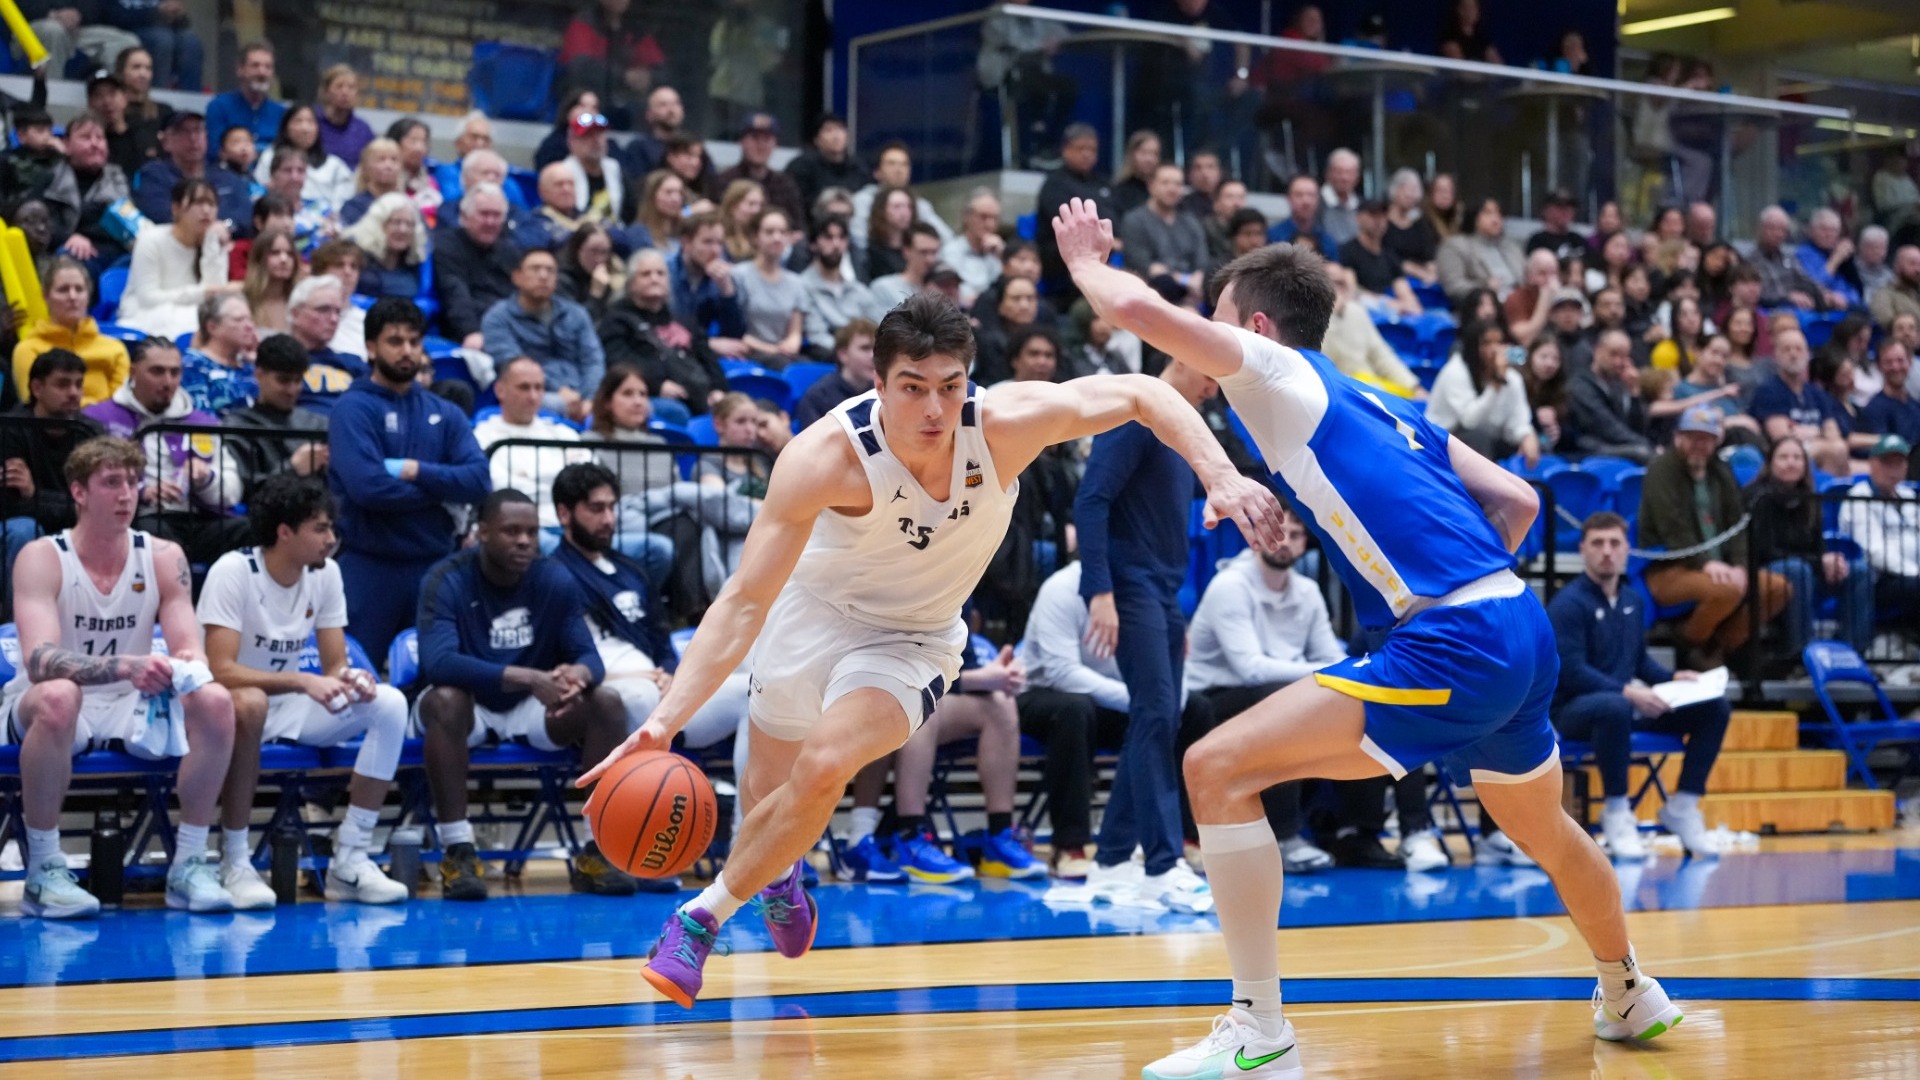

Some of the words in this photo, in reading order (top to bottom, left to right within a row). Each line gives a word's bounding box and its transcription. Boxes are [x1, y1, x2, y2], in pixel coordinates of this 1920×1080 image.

[74, 614, 136, 632] T-BIRDS
[83, 638, 117, 656] 14
[640, 794, 688, 870] Wilson
